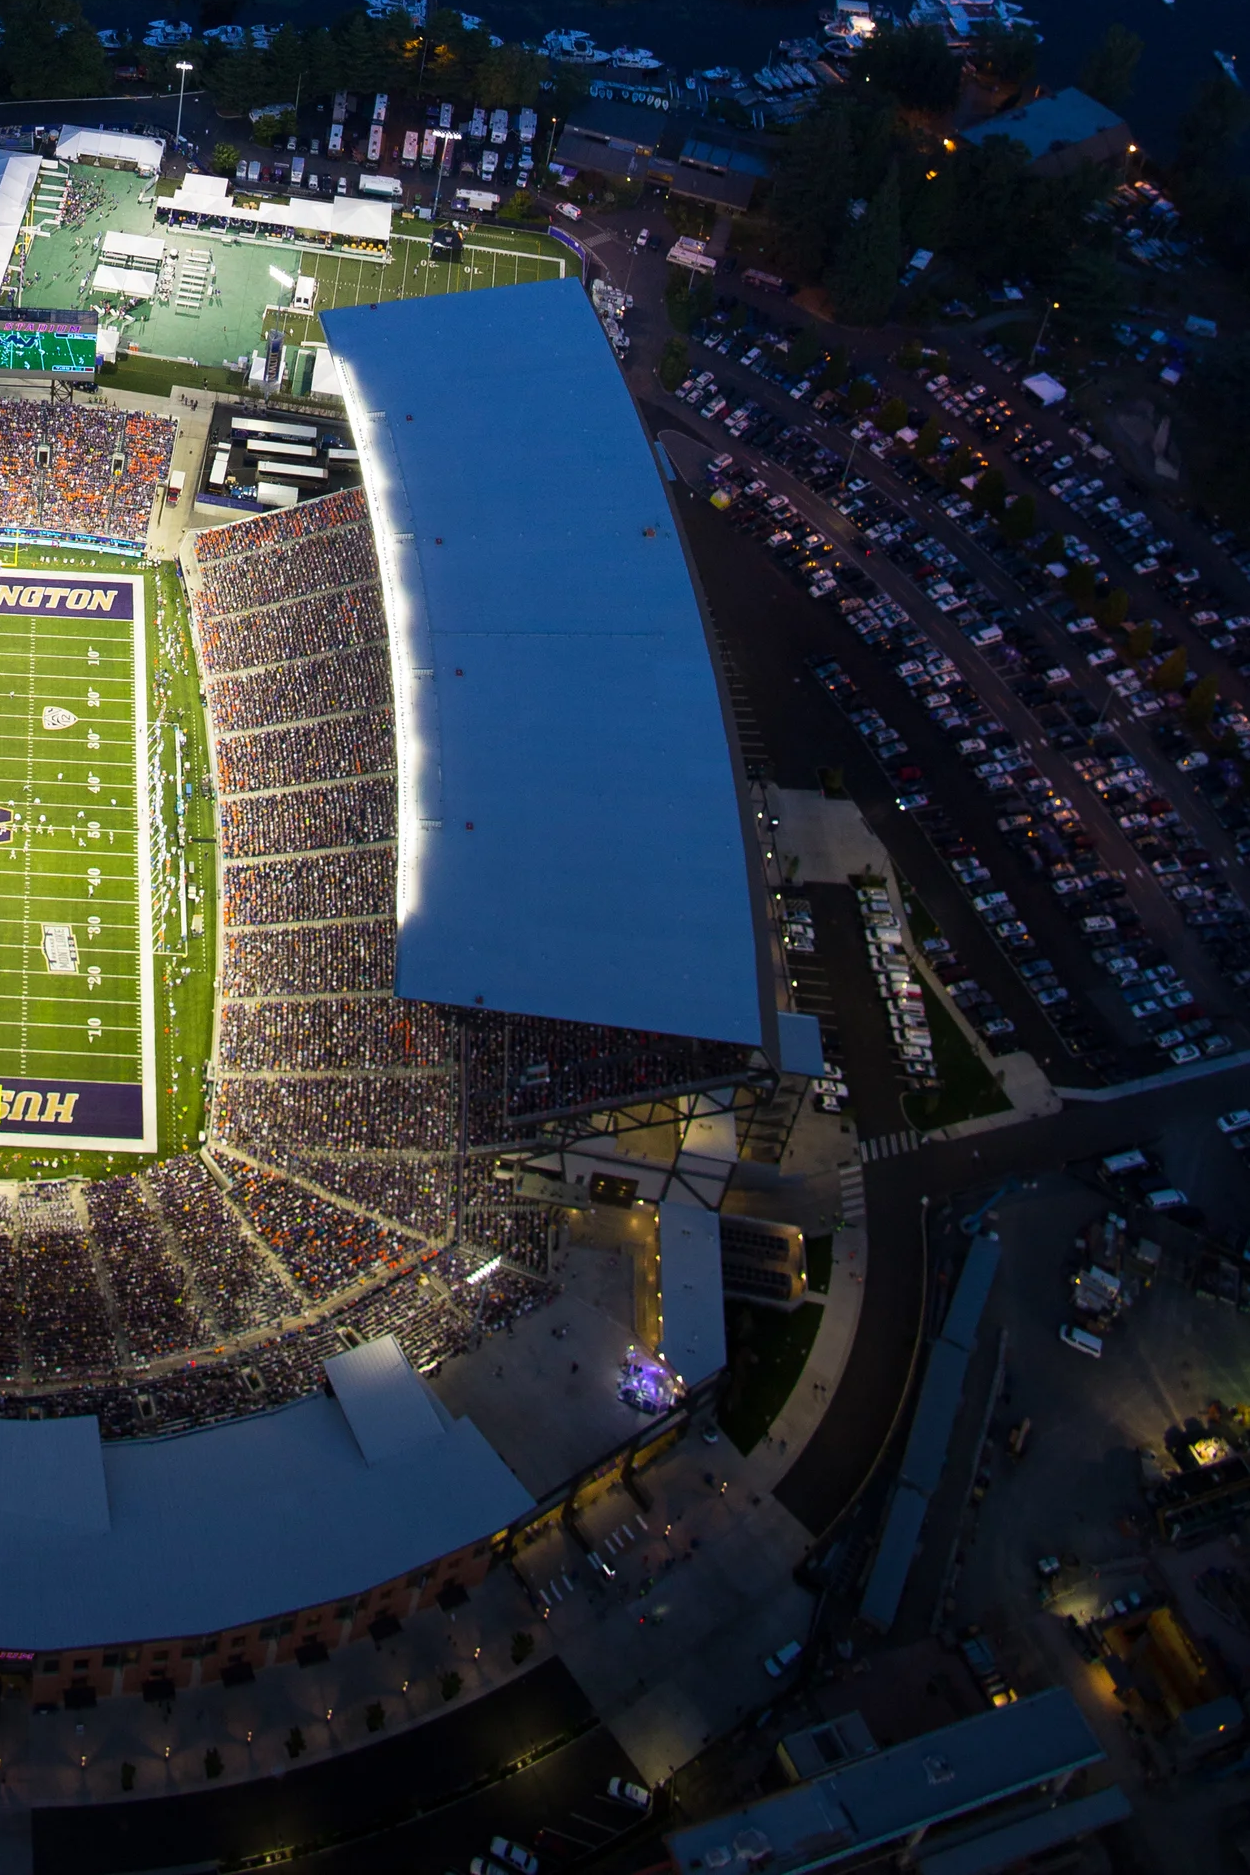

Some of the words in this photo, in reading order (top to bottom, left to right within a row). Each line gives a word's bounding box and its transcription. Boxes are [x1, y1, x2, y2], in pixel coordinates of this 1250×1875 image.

[420, 259, 436, 268] 20
[464, 266, 479, 274] 10
[4, 322, 82, 333] STADIUM
[87, 651, 100, 665] 10
[87, 691, 100, 707] 20
[61, 714, 71, 723] 12
[87, 733, 100, 750] 30
[87, 776, 100, 794] 40
[87, 821, 101, 839] 50
[87, 867, 101, 887] 40
[87, 916, 101, 935] 30
[87, 966, 101, 986] 20
[87, 1017, 102, 1037] 10
